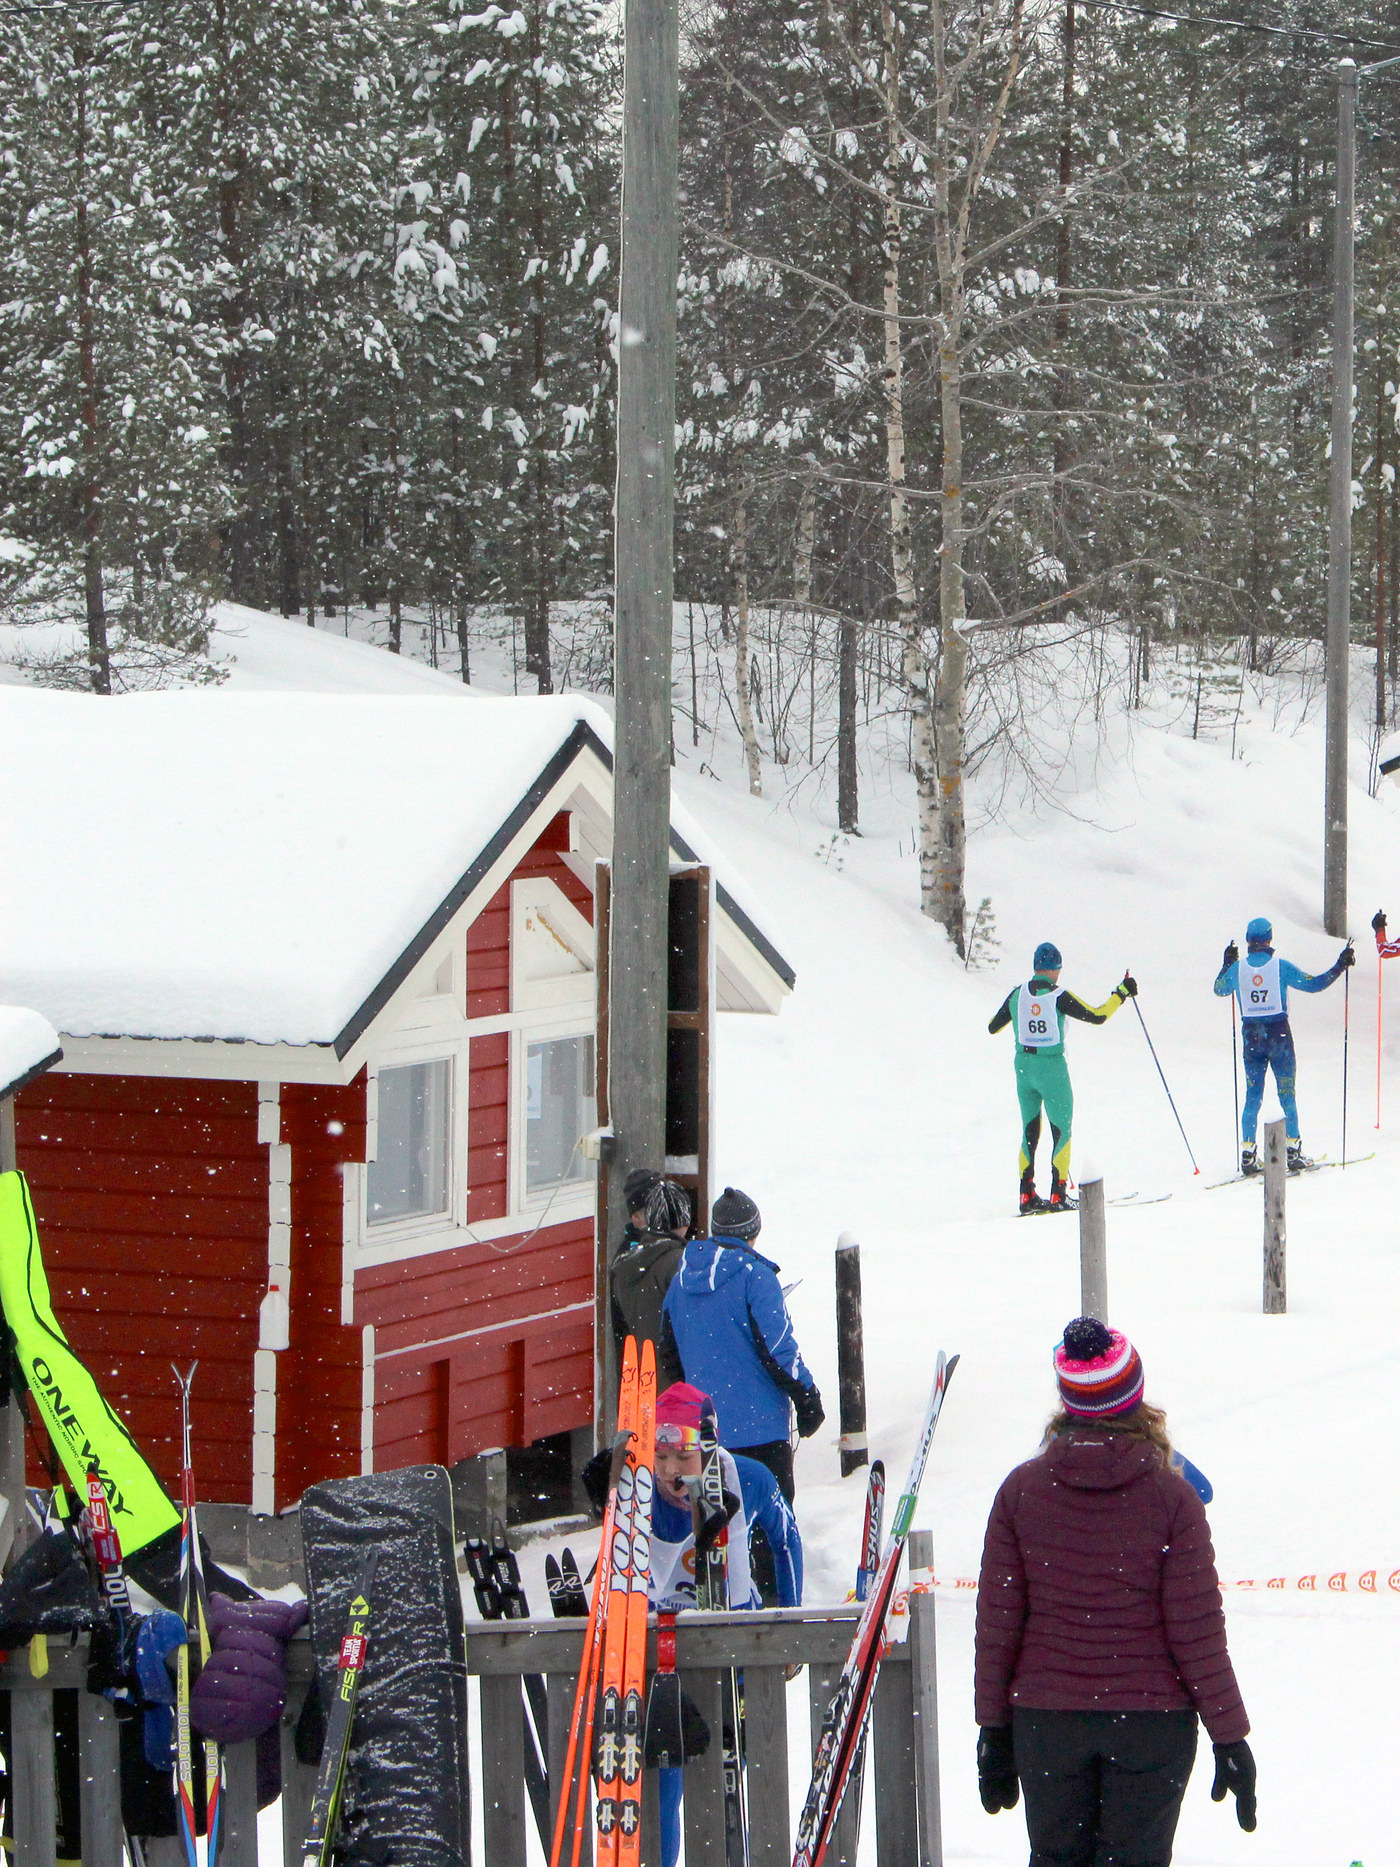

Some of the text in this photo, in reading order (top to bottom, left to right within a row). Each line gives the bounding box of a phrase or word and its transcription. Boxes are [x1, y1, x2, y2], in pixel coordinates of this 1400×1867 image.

[1029, 1020, 1047, 1033] 68
[1251, 990, 1268, 1003] 67
[40, 1392, 63, 1431] AUTHENTIC
[62, 1431, 79, 1459] NORDIC
[77, 1459, 88, 1477] SPO
[609, 1465, 634, 1594] YOKO
[631, 1465, 653, 1595] YOKO
[866, 1506, 880, 1571] SHUS
[343, 1639, 352, 1657] TEAM
[177, 1704, 192, 1782] salomon
